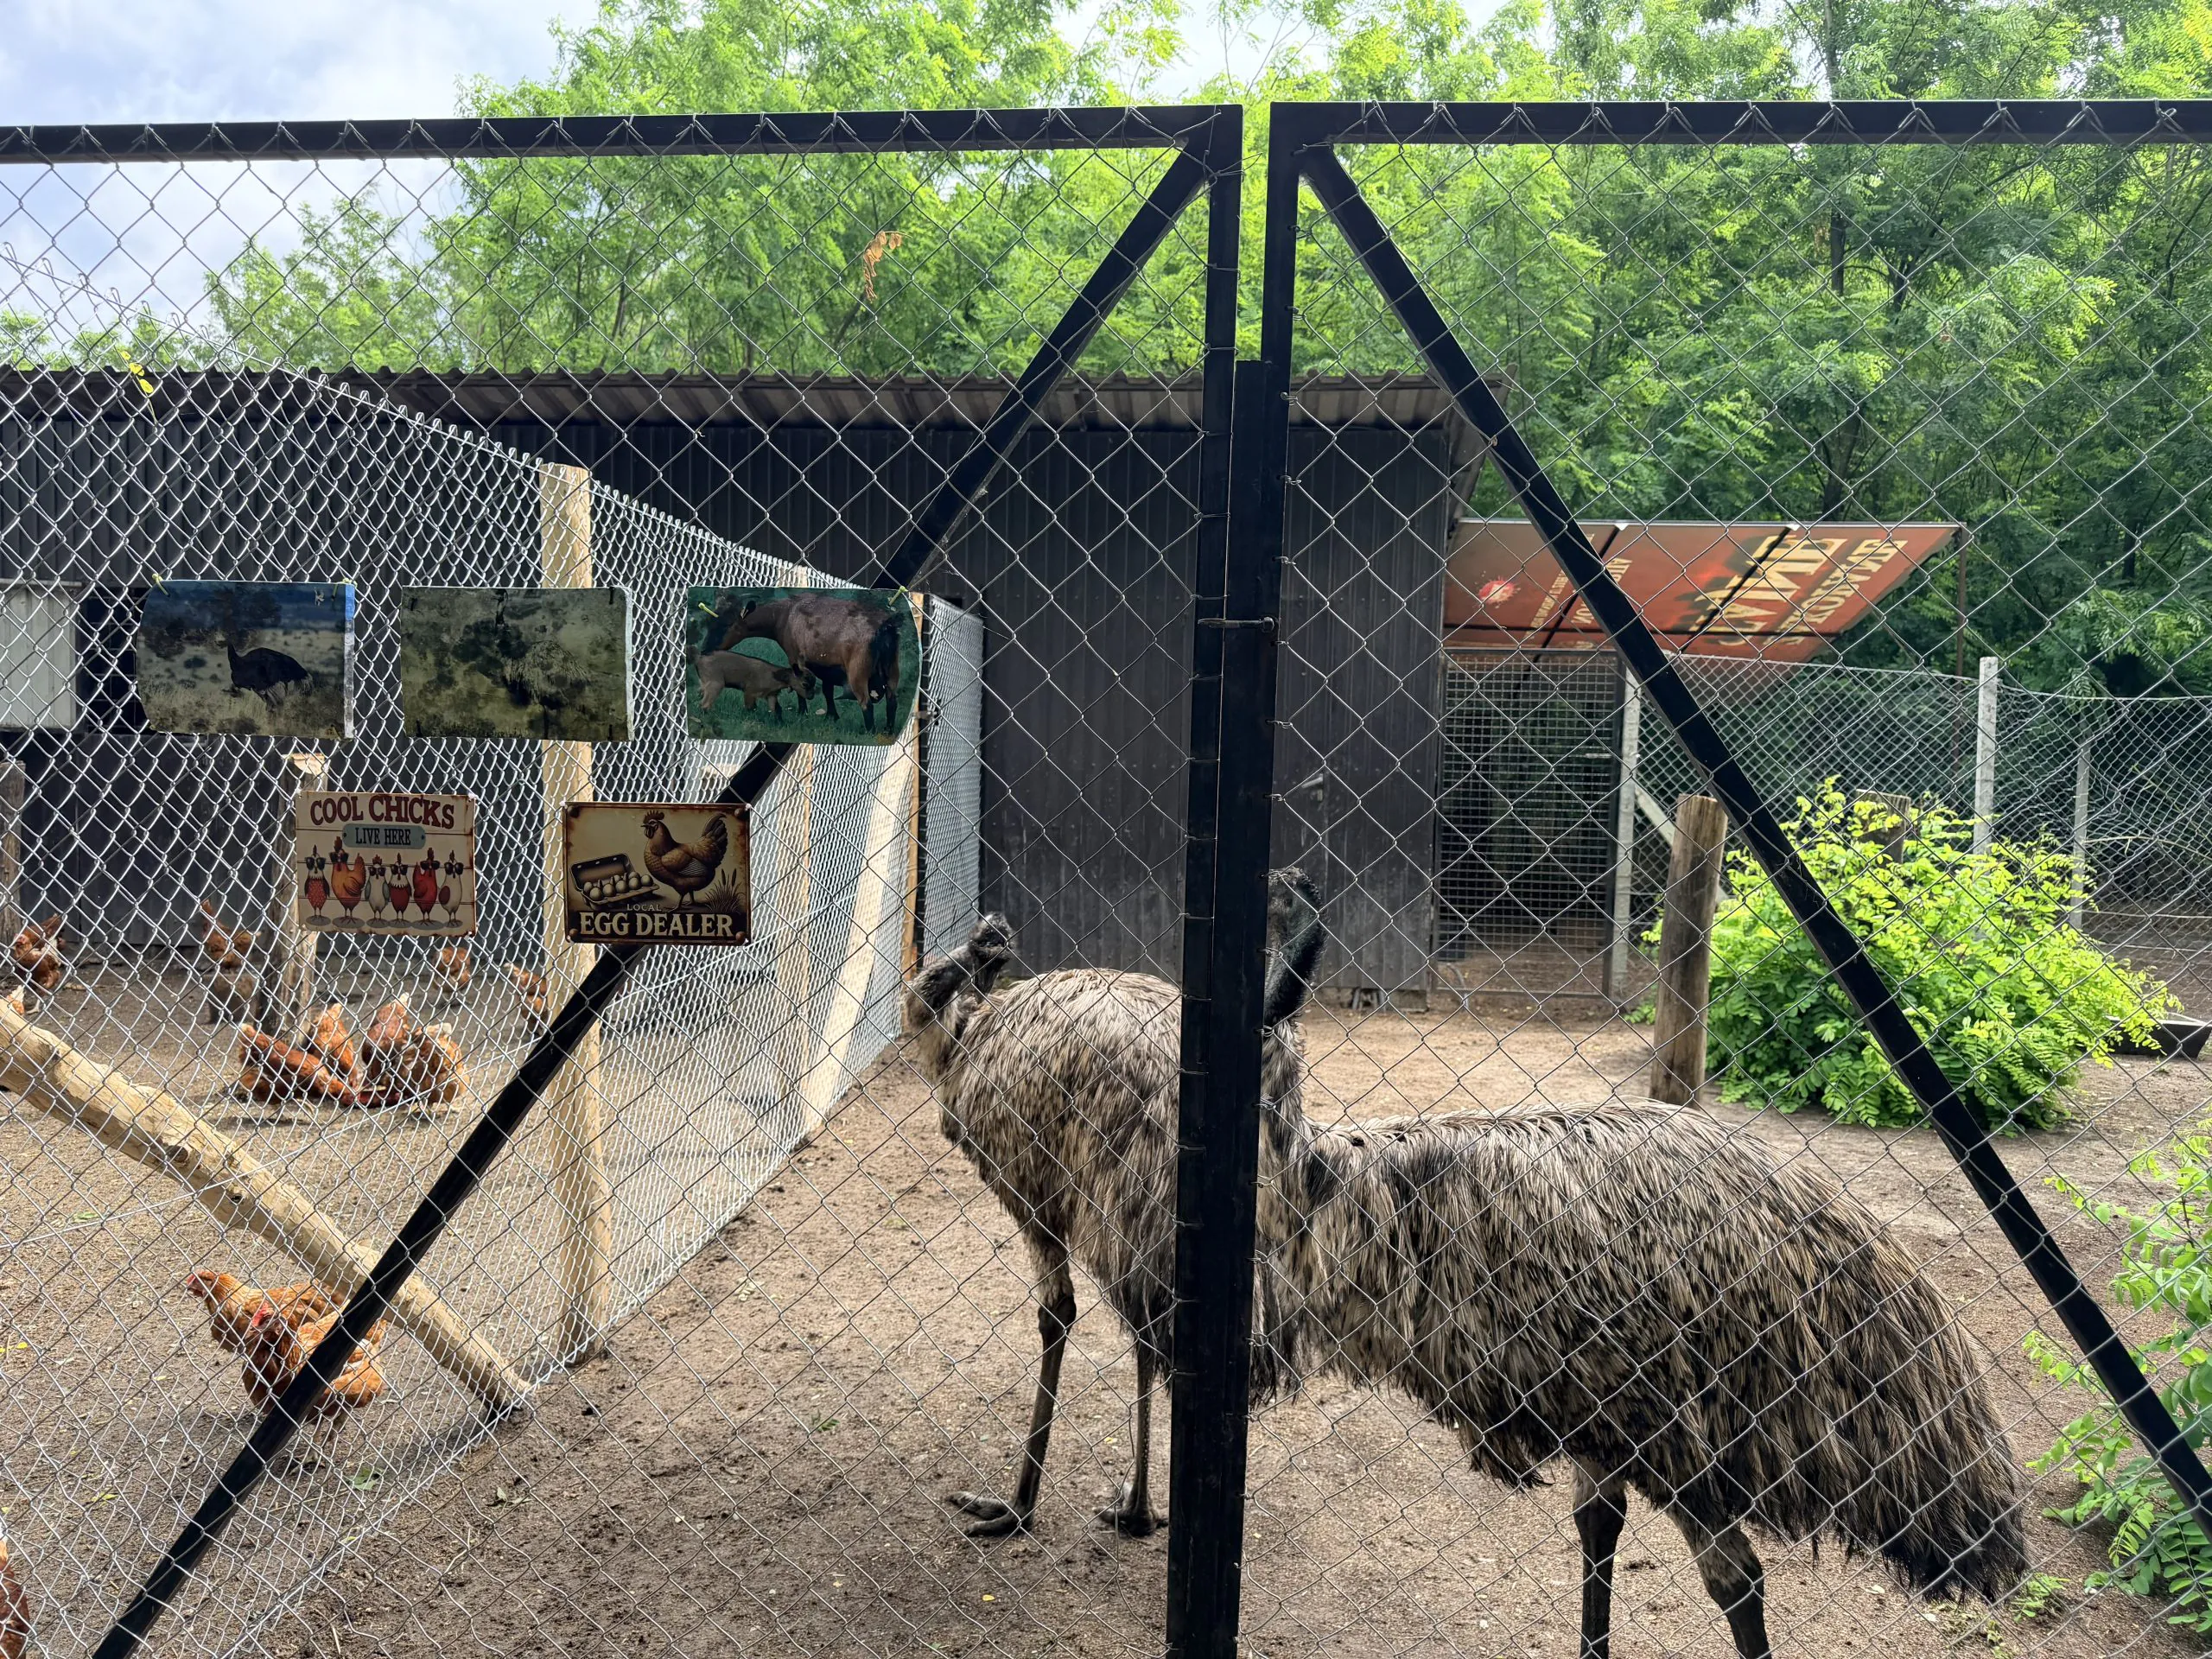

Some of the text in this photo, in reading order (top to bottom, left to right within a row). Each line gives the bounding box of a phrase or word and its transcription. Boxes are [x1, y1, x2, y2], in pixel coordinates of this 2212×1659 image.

[310, 795, 454, 830] COOL CHICKS
[355, 828, 411, 846] LIVE HERE
[580, 912, 734, 937] EGG DEALER
